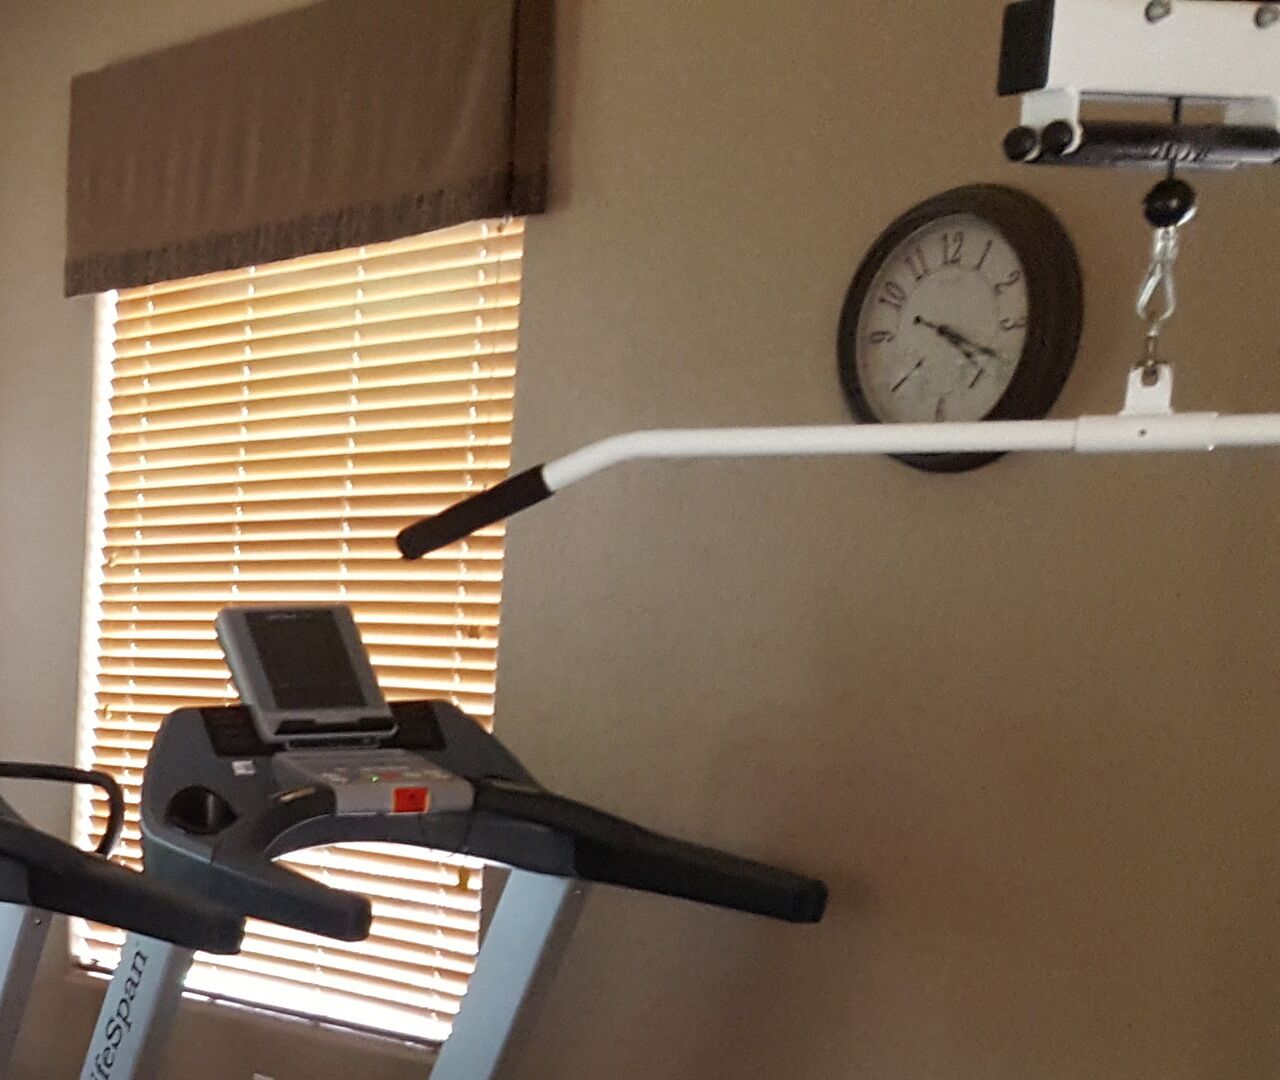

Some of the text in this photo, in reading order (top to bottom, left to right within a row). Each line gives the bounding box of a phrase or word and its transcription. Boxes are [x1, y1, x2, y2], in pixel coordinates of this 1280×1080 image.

[941, 230, 966, 265] 12
[904, 247, 930, 282] 11
[878, 281, 908, 310] 10
[994, 269, 1021, 296] 2
